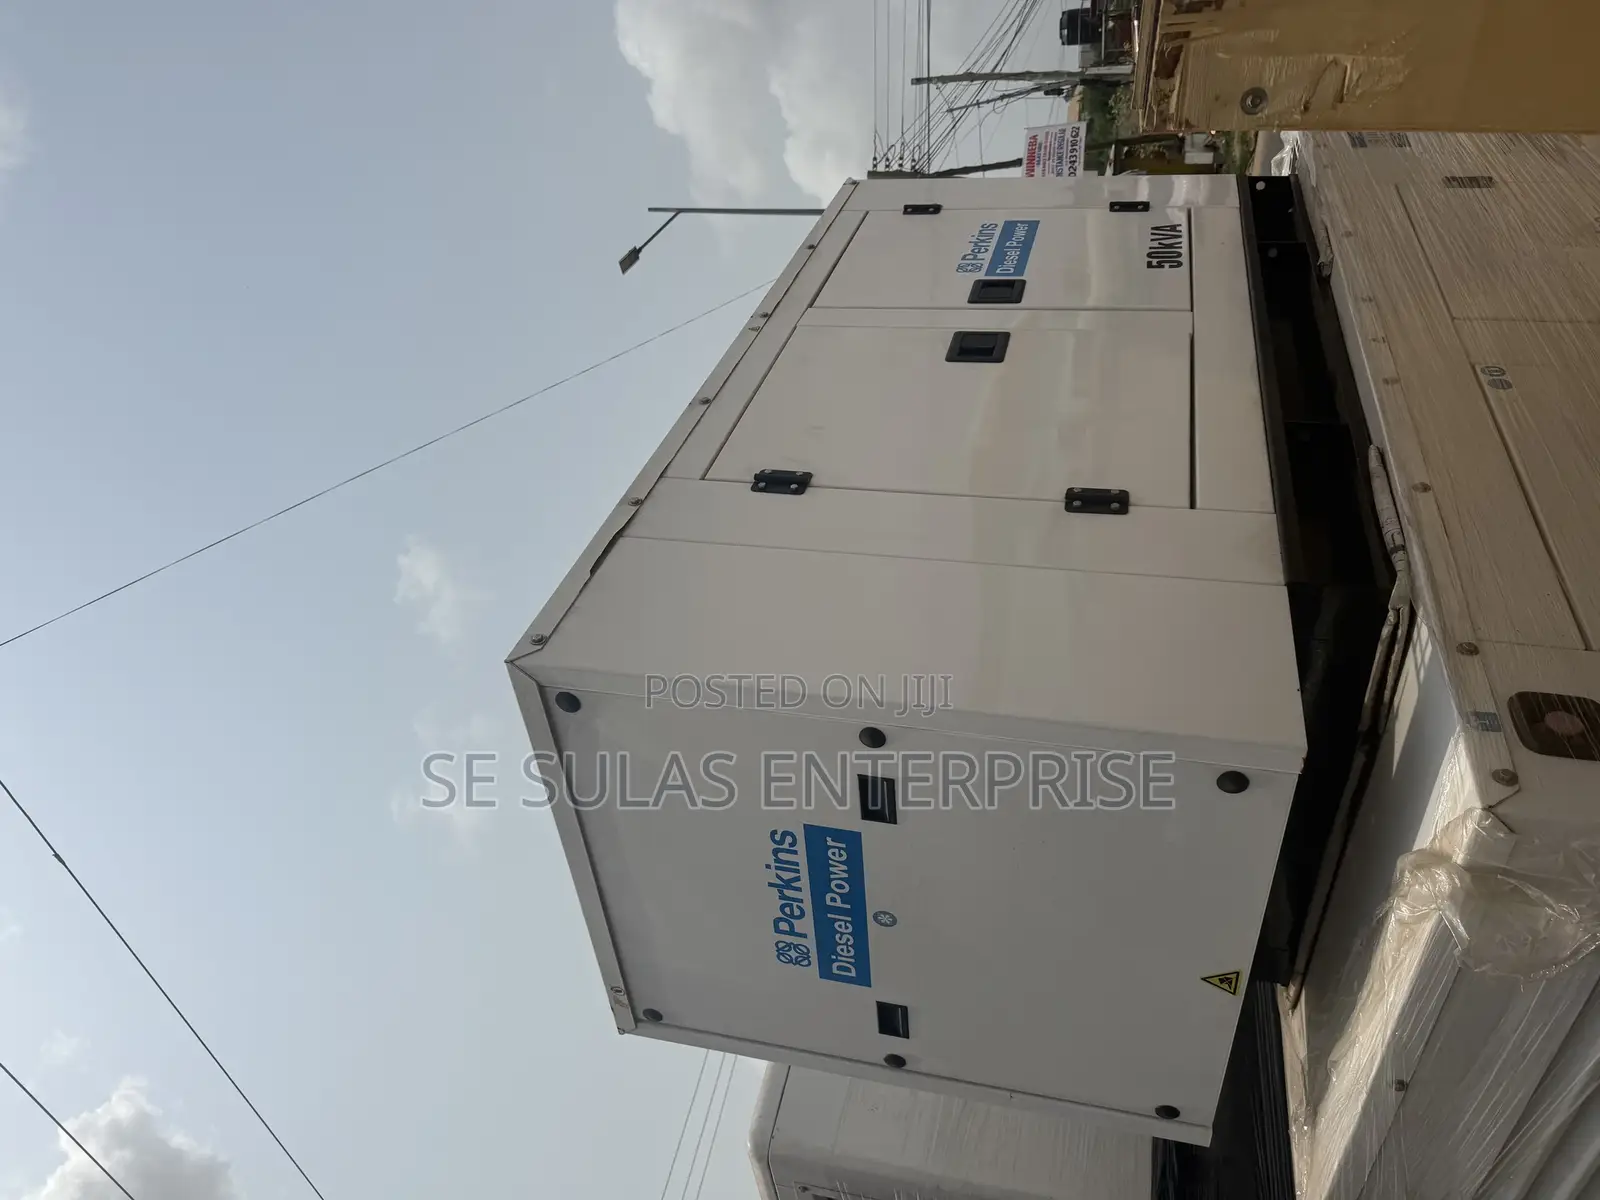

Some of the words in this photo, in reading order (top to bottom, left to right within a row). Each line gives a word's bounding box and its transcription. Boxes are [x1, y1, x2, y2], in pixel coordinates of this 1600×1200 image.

[961, 222, 999, 262] Perkins
[1005, 222, 1029, 250] Power
[1146, 223, 1184, 269] 50kVA
[995, 249, 1021, 275] Diesel
[765, 829, 808, 939] Perkins
[825, 836, 852, 909] Power
[826, 912, 857, 978] Diesel
